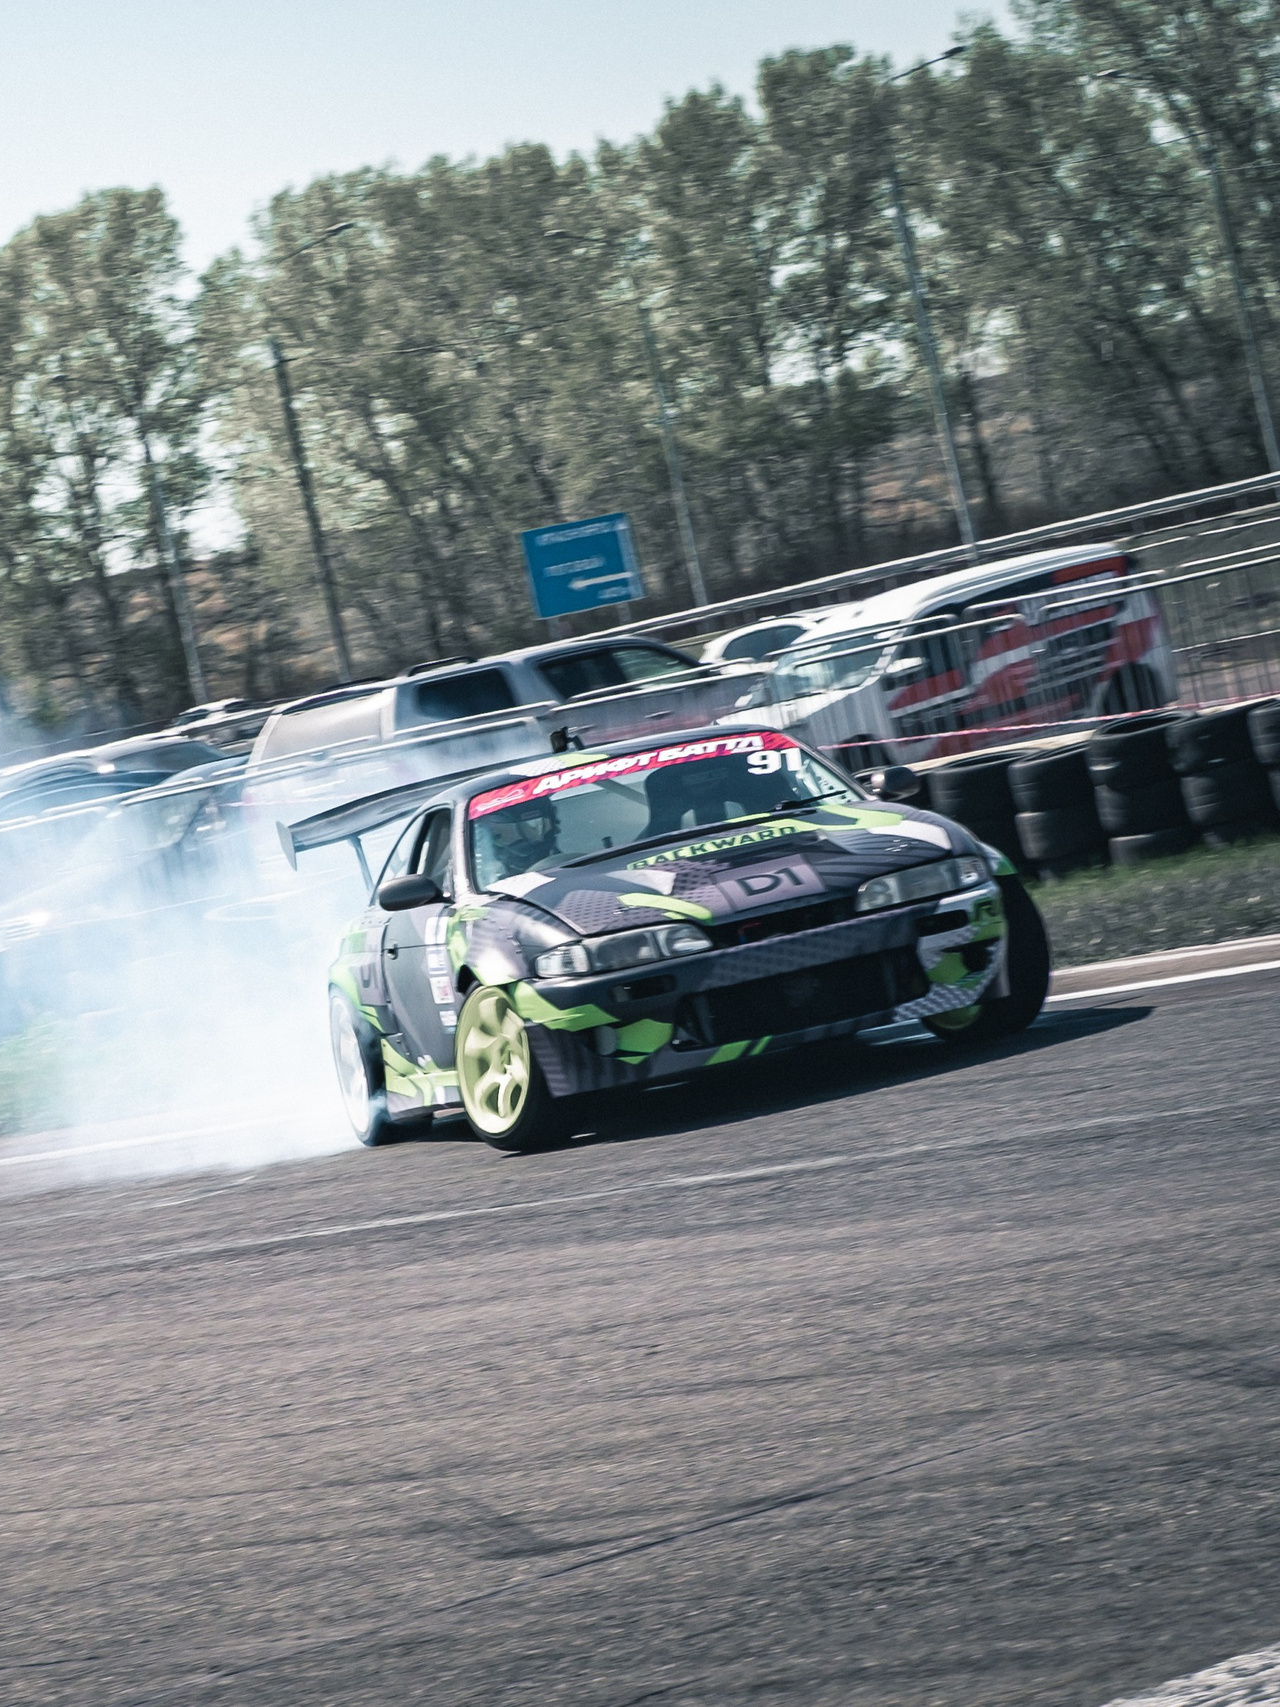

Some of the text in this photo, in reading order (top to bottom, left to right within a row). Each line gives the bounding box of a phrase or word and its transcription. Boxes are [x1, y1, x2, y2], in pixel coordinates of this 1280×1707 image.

[532, 751, 658, 794] ДРИФТ
[747, 748, 803, 776] 91
[632, 825, 796, 870] BACKWARD
[734, 867, 804, 897] D1
